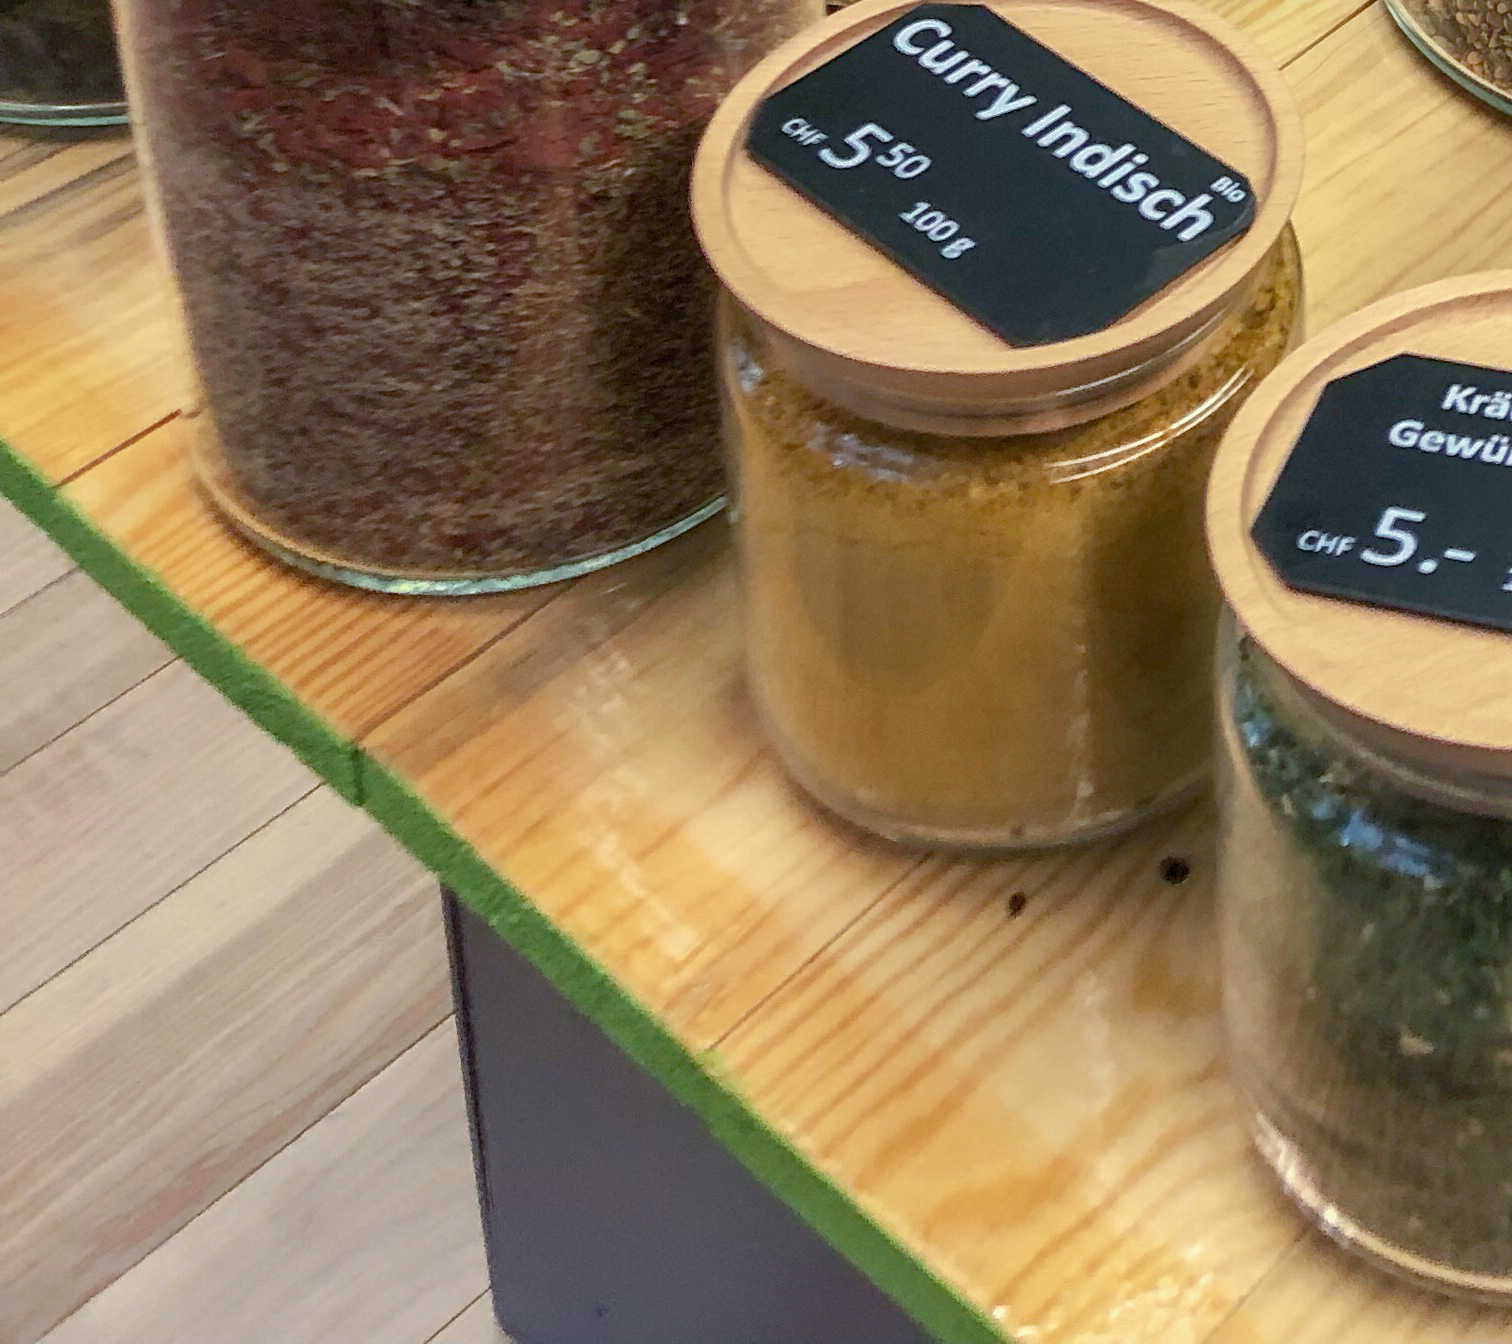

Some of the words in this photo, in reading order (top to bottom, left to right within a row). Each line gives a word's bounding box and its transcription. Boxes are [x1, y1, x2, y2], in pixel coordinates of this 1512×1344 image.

[779, 116, 828, 148] CHF
[891, 17, 1040, 121] Curry
[1020, 103, 1216, 243] Indisch
[1210, 174, 1248, 205] Bio
[898, 199, 960, 244] 100
[1296, 527, 1357, 558] CHF
